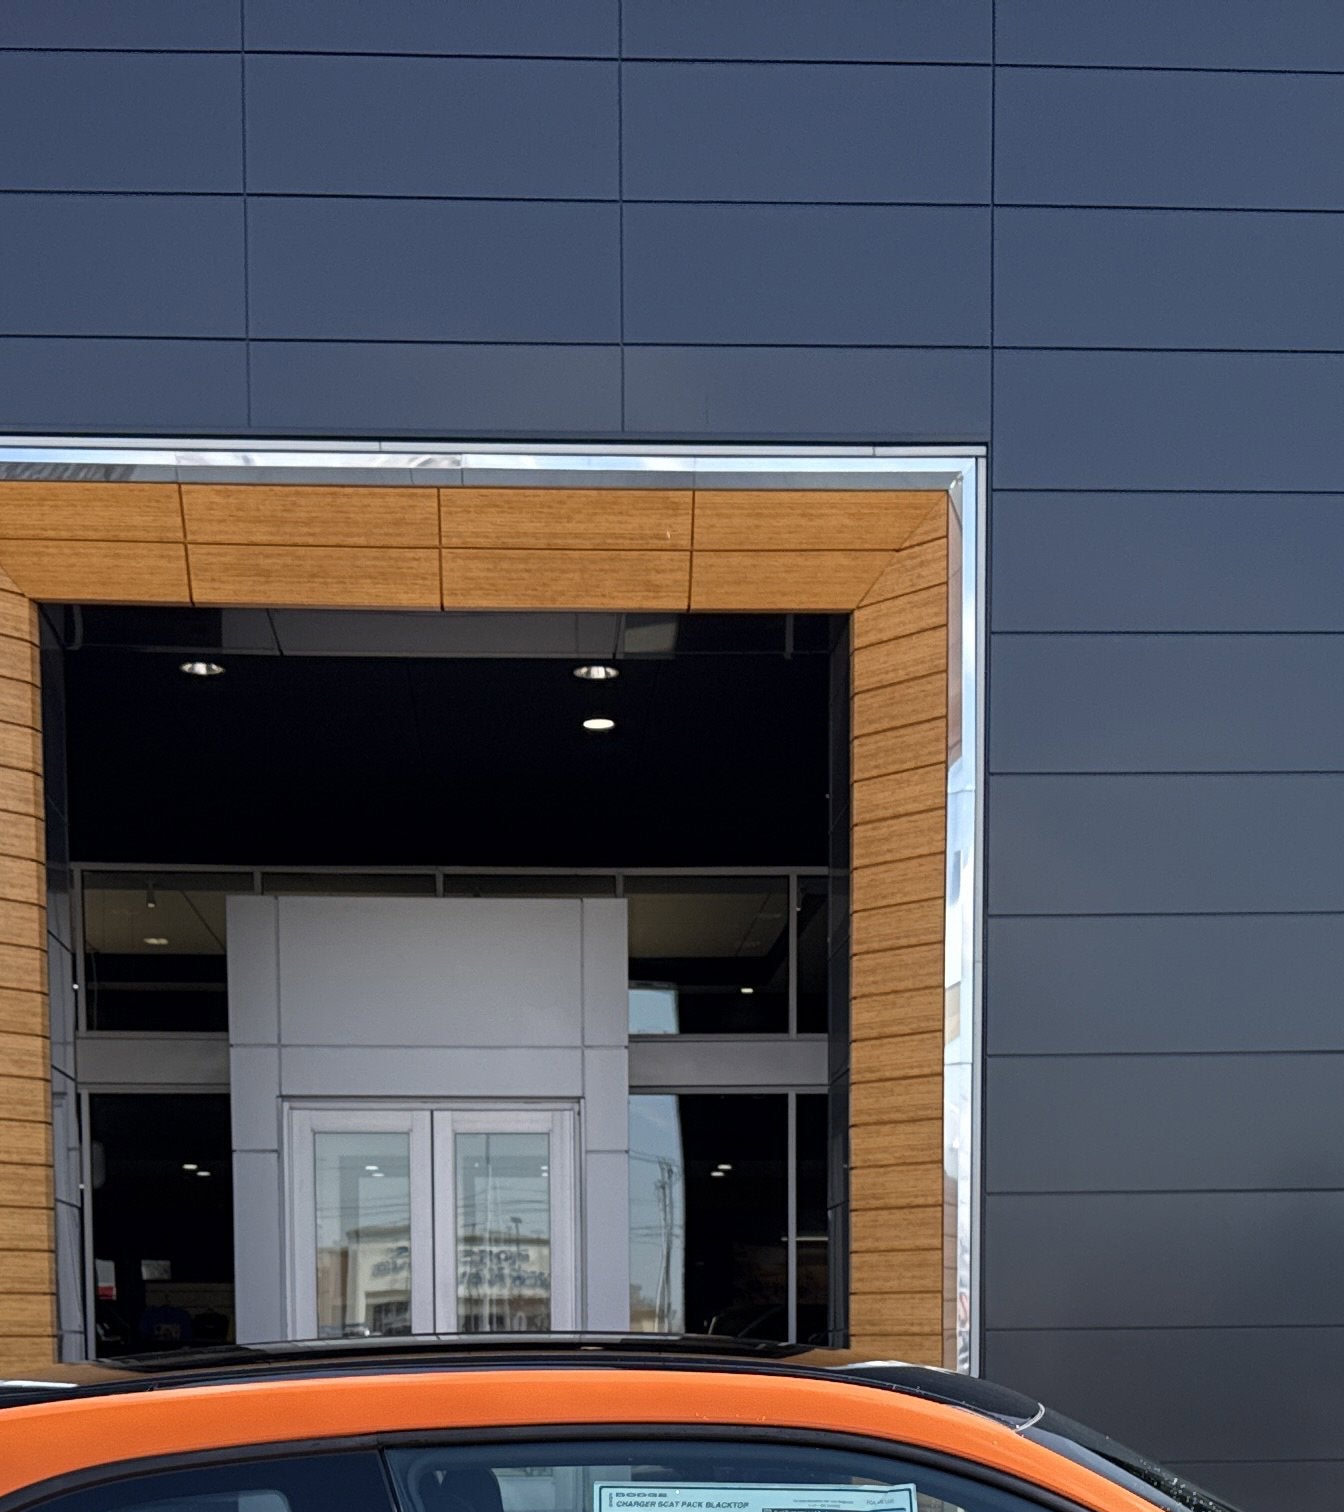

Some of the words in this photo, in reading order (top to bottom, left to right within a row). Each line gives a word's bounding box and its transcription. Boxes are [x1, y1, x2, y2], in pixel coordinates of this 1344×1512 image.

[616, 1500, 656, 1508] CHARGER
[658, 1500, 680, 1508] SCAT
[705, 1501, 749, 1509] BLACKTOP
